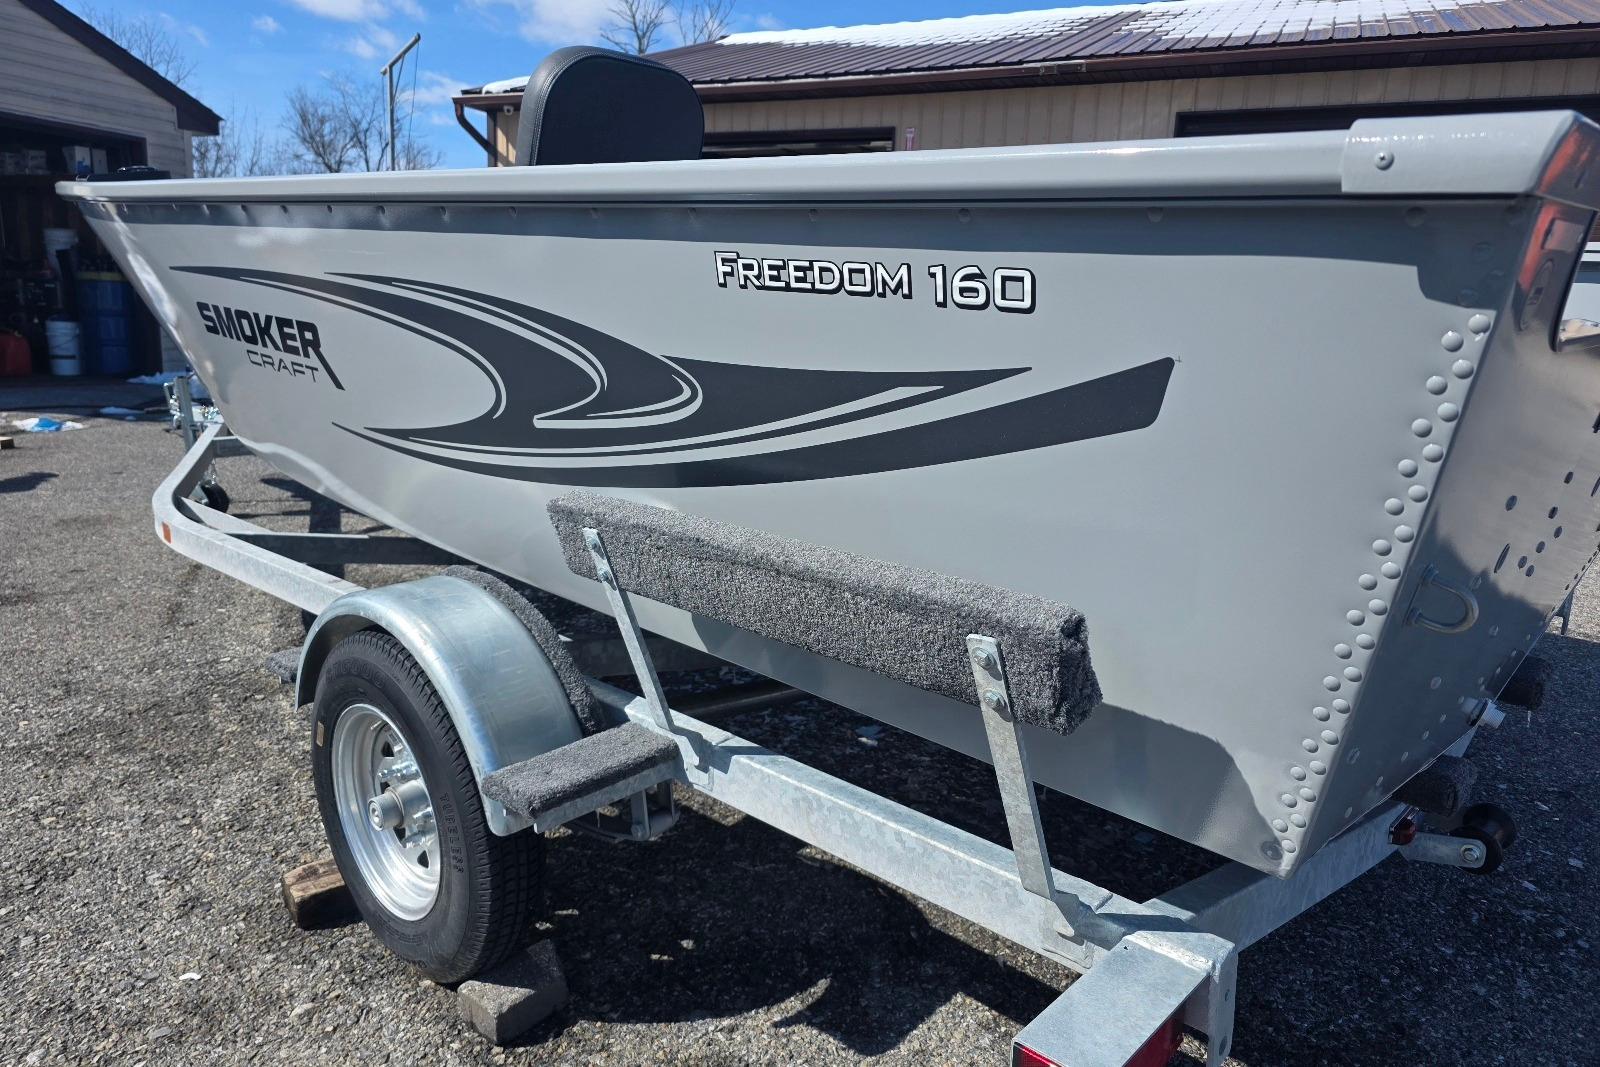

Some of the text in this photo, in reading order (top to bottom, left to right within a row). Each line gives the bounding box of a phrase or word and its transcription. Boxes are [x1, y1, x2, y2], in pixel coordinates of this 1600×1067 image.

[714, 251, 1036, 314] FREEDOM 160
[196, 301, 345, 391] SMOKER
[246, 350, 319, 383] CRAFT
